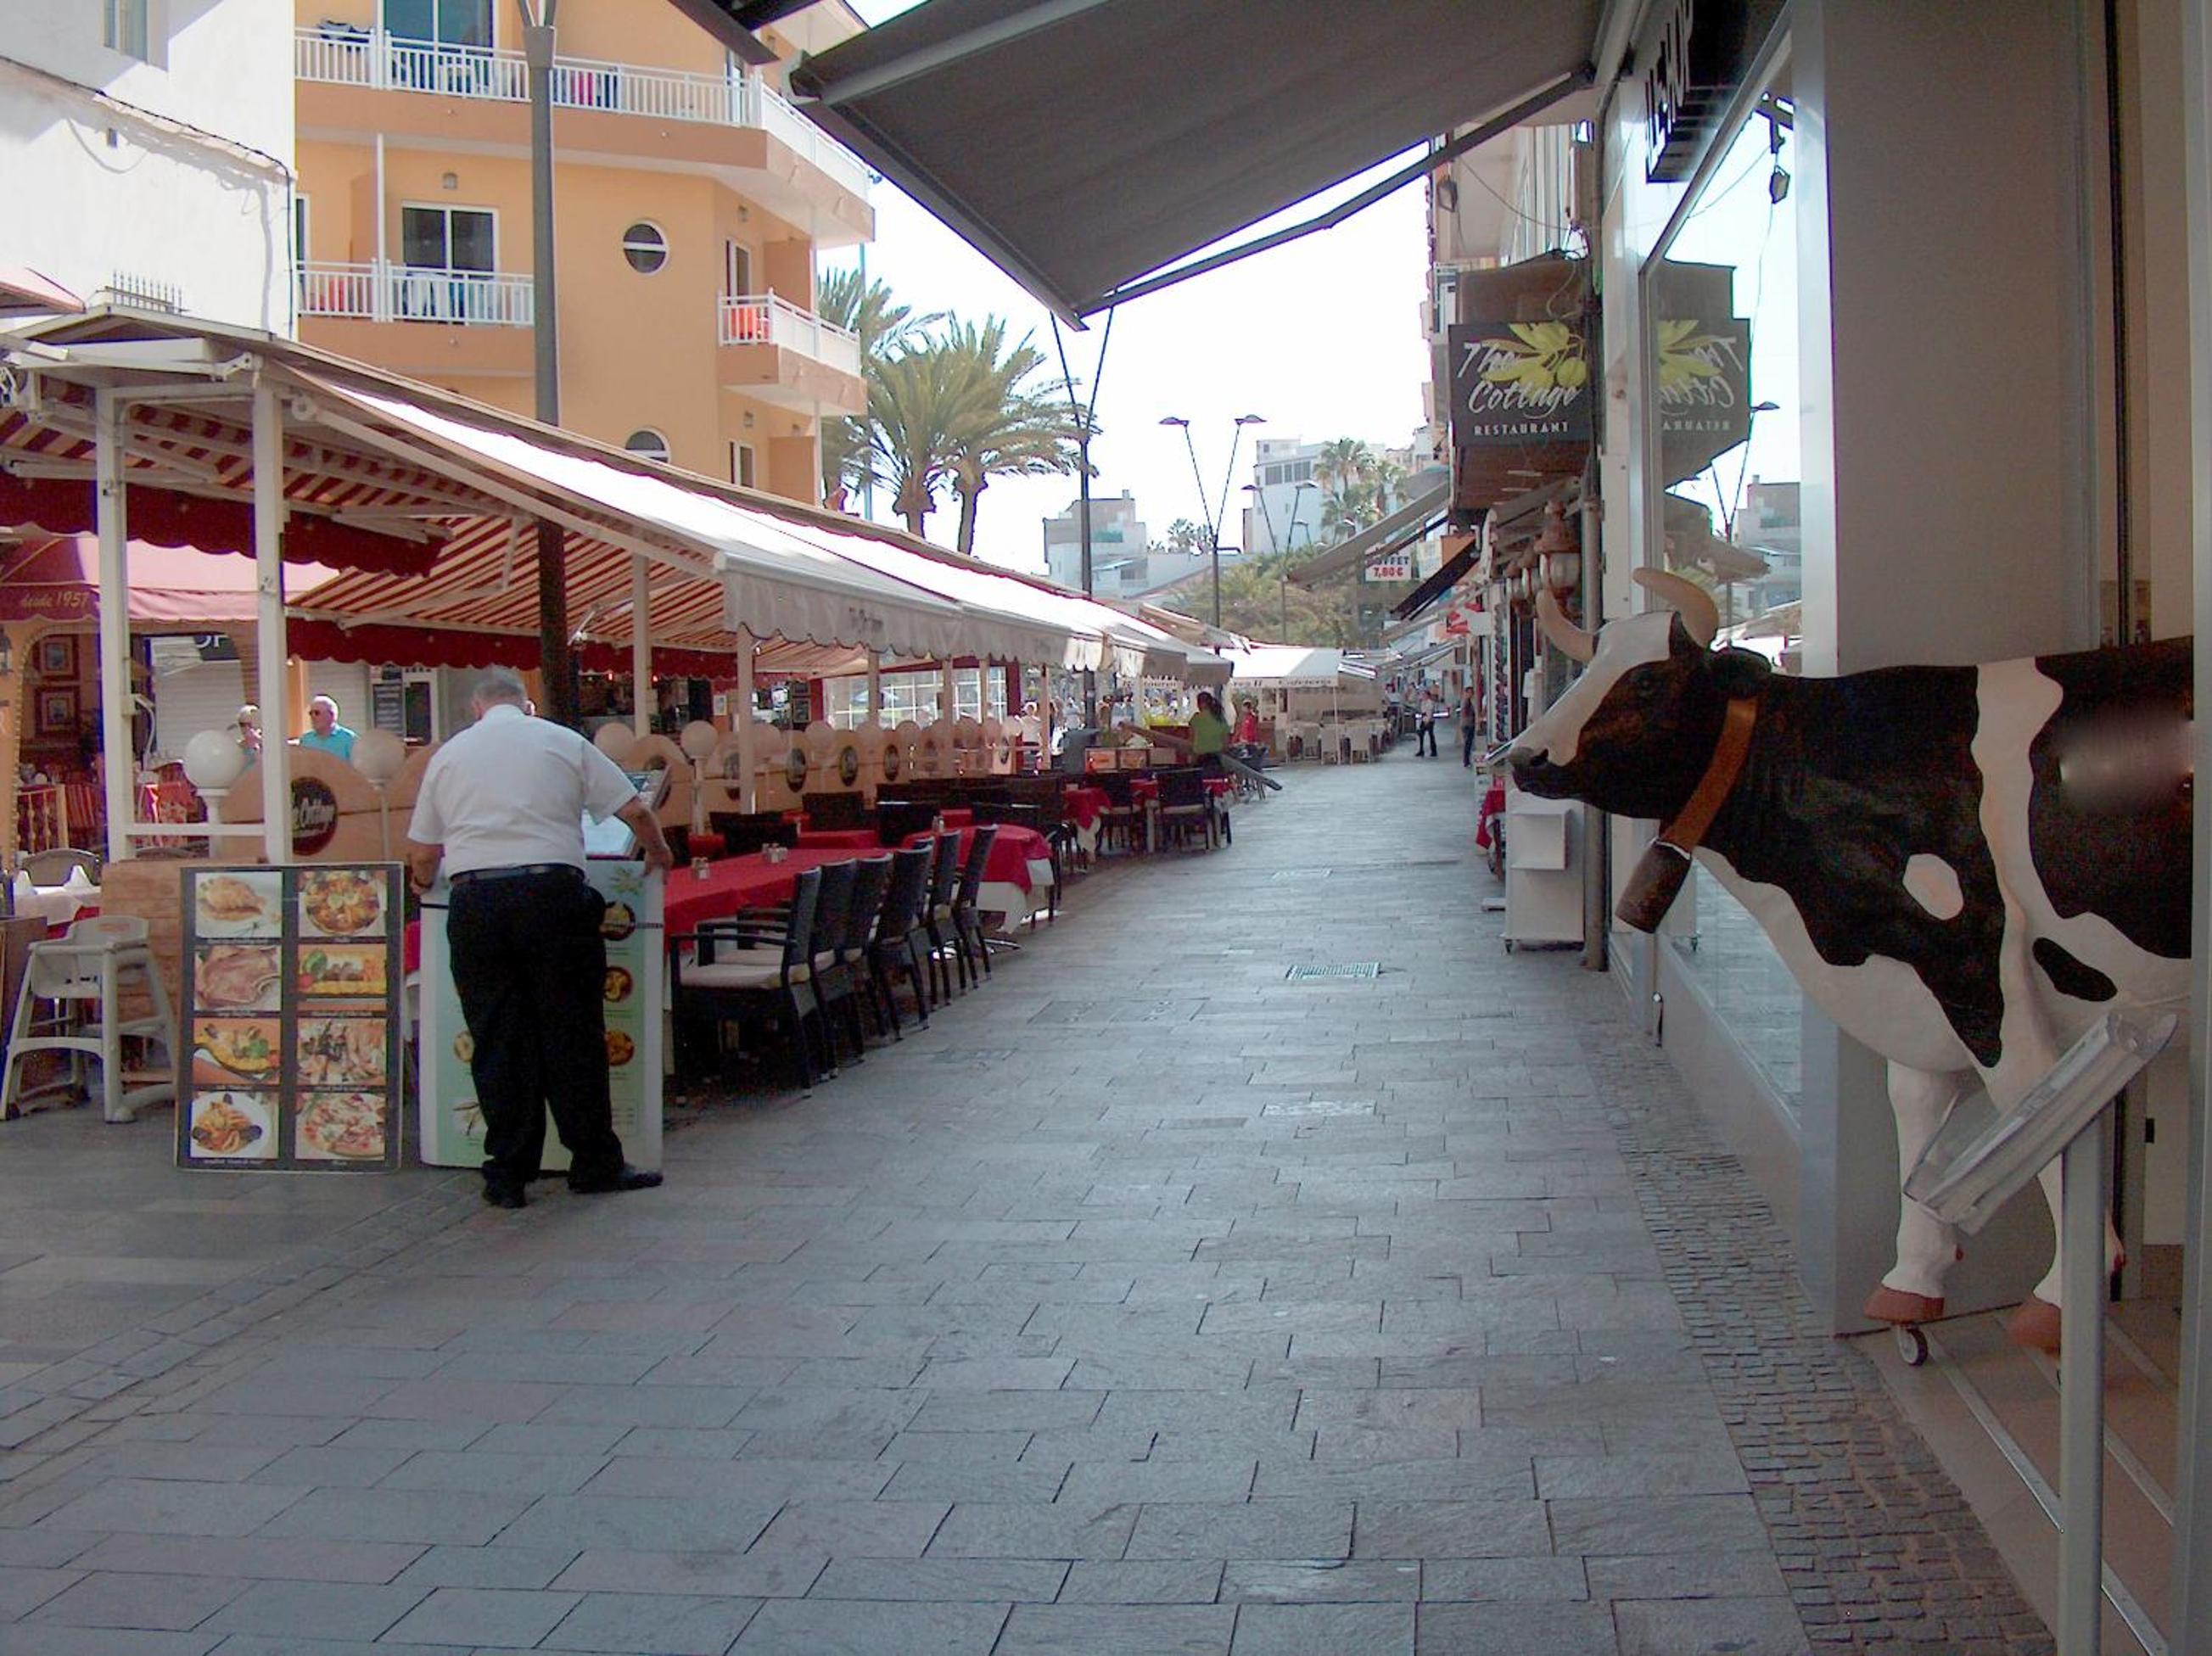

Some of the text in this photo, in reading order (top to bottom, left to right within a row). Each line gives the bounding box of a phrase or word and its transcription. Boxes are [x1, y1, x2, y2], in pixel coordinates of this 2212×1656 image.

[1457, 341, 1519, 378] The
[1468, 380, 1582, 419] Cottage
[1474, 422, 1569, 436] RESTAURANT
